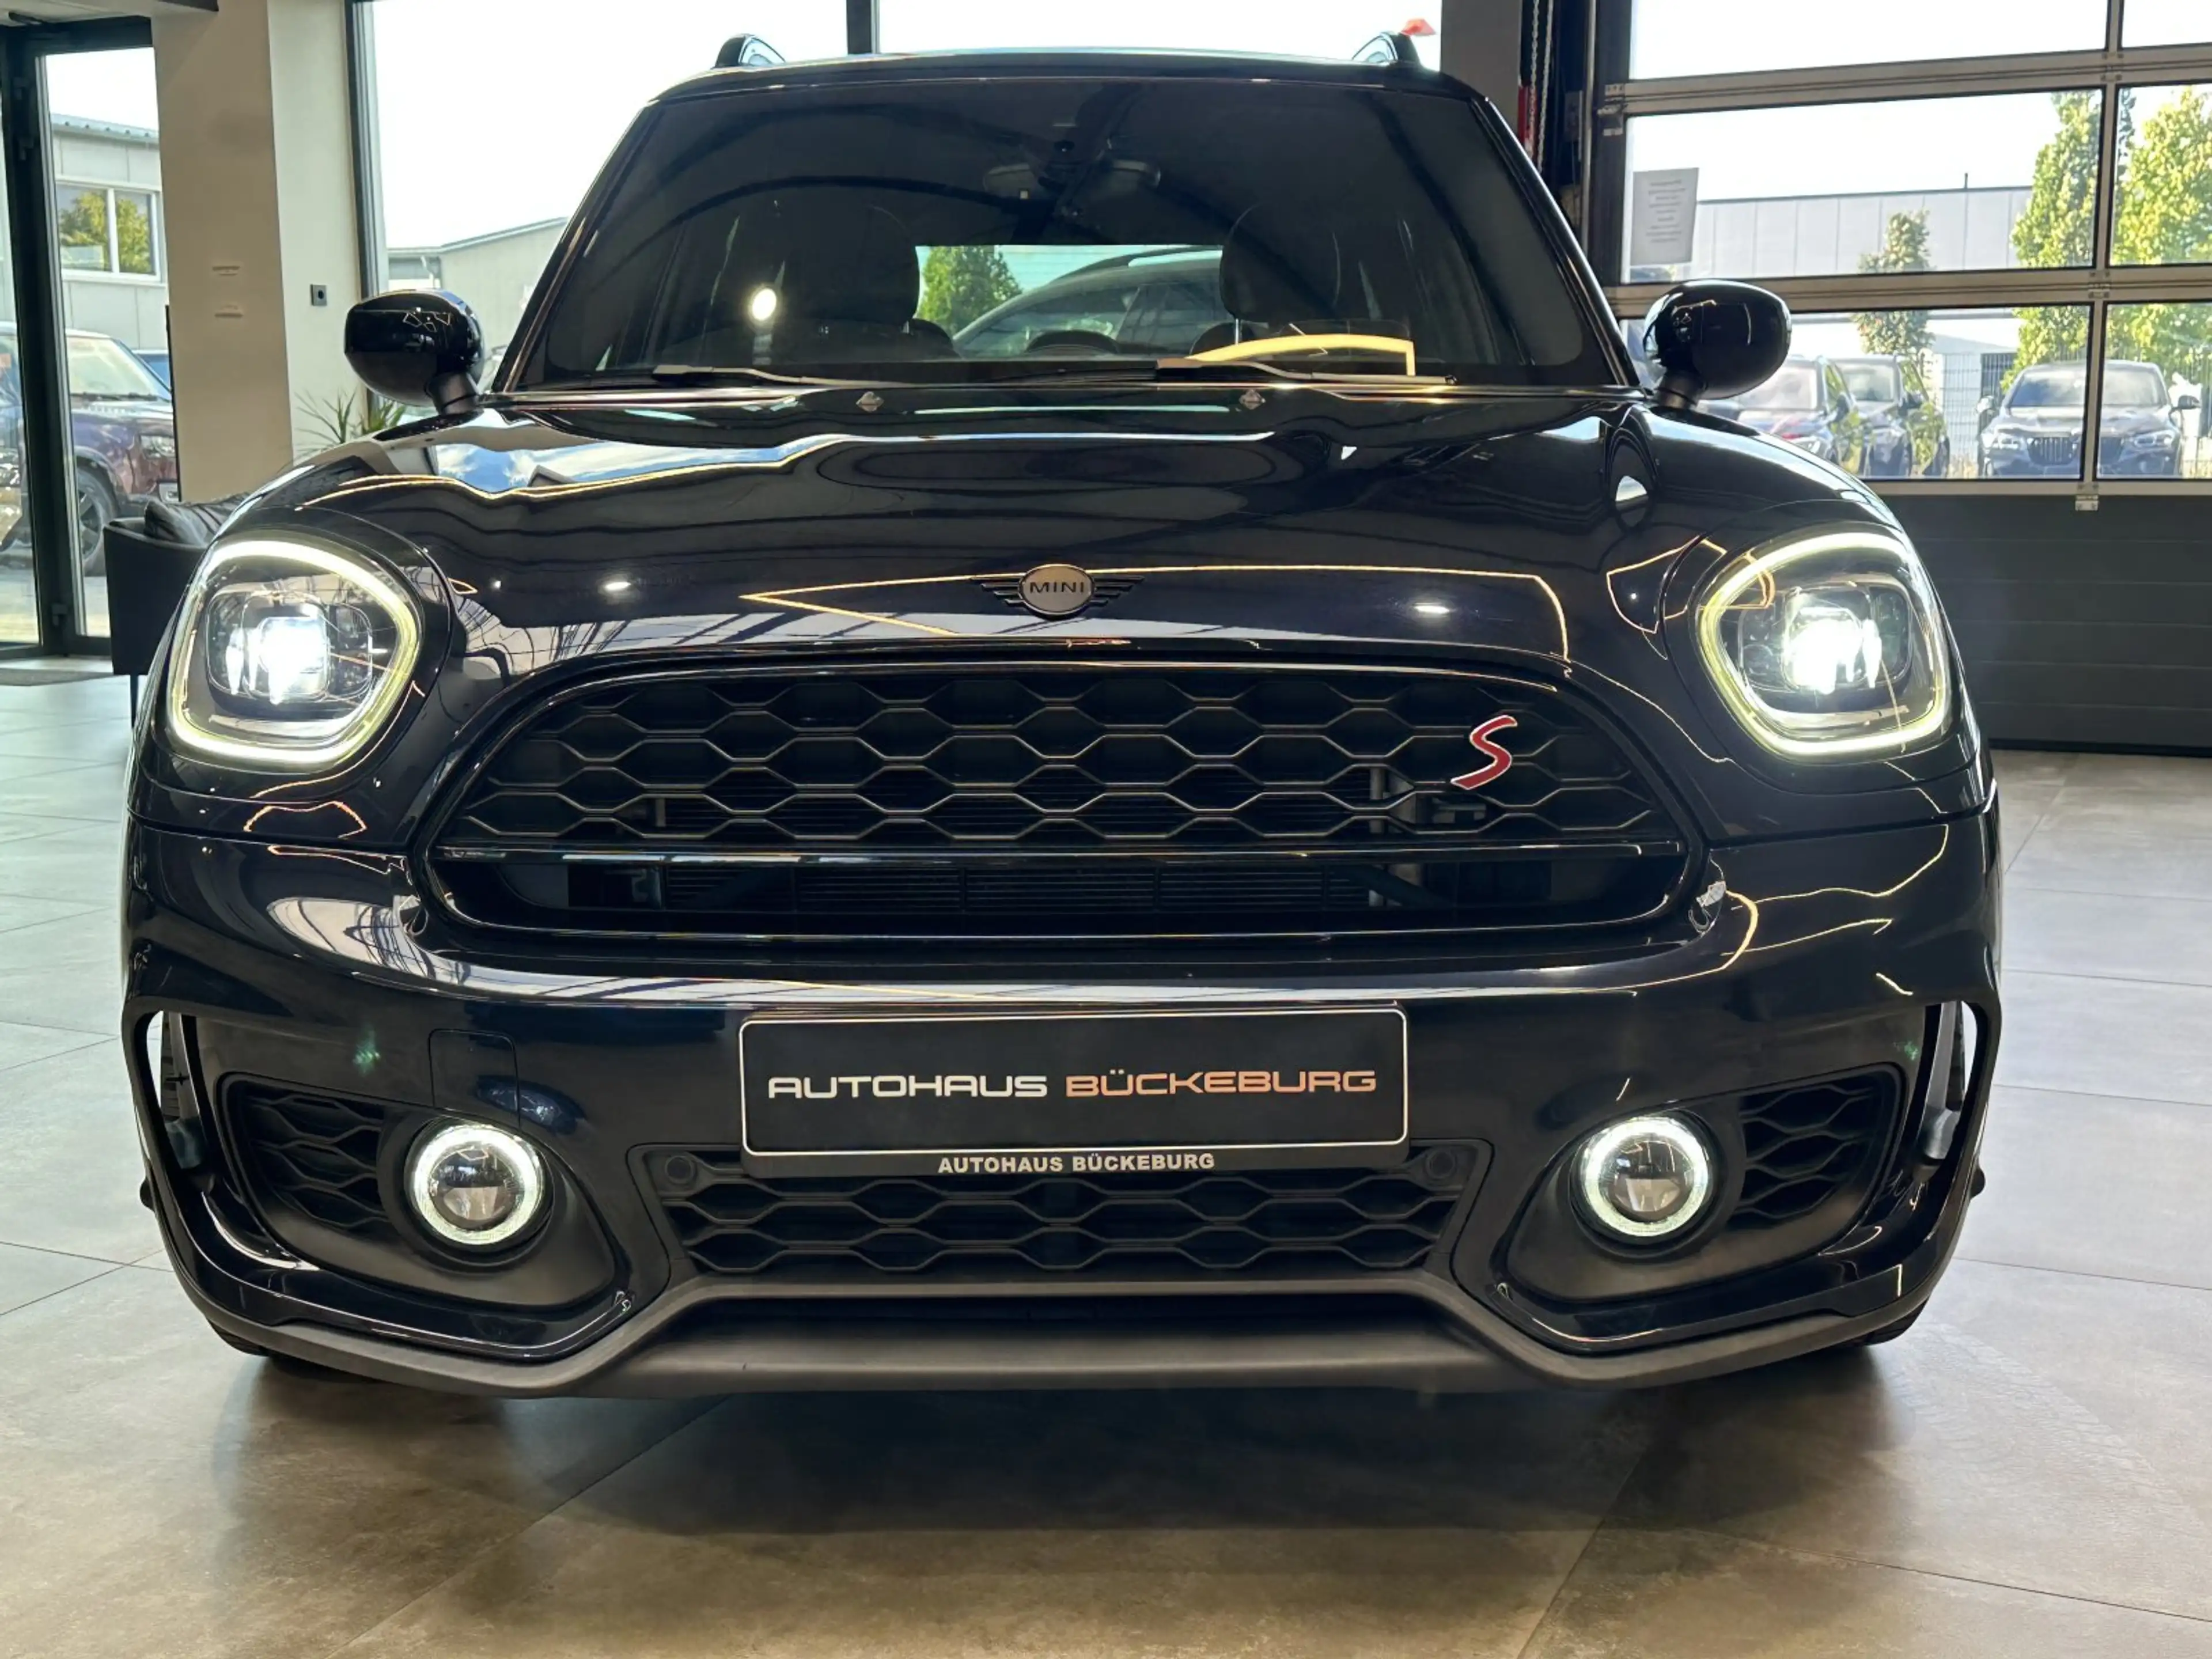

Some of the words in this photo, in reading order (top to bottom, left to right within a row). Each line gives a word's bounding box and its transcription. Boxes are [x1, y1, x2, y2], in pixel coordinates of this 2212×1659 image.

[1029, 582, 1085, 593] MINI
[1450, 714, 1518, 790] S
[768, 1075, 1048, 1099] AUTOHAUS
[1066, 1069, 1377, 1097] BÜCKEBURG
[938, 1156, 1064, 1173] AUTOHAUS
[1073, 1153, 1215, 1172] BÜCKEBURG
